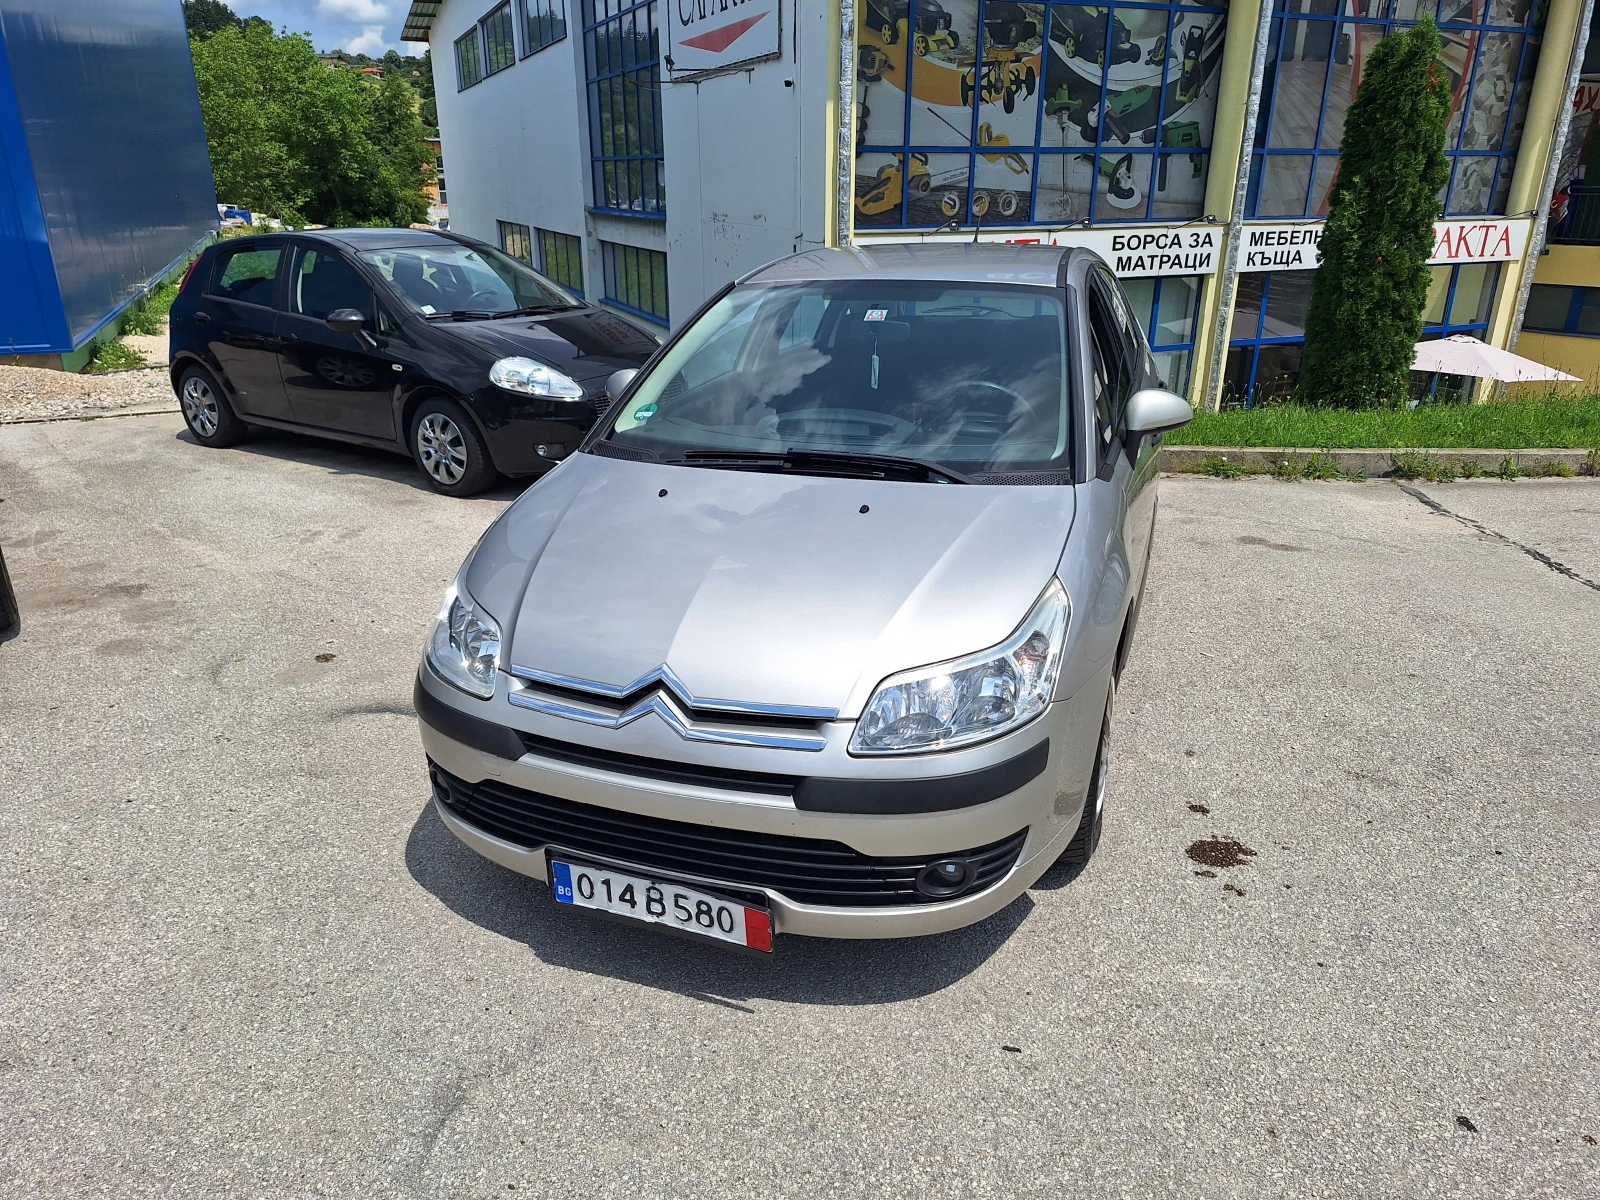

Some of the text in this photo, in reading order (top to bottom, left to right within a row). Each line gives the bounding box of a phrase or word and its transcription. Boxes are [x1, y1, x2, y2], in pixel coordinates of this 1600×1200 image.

[1112, 232, 1213, 251] БОРСА ЗА
[1249, 230, 1323, 247] МЕБЕЛН
[1431, 224, 1511, 259] АКТА
[1116, 252, 1211, 272] МАТРАЦИ
[1246, 250, 1303, 267] КЪЩА
[557, 884, 572, 897] BG
